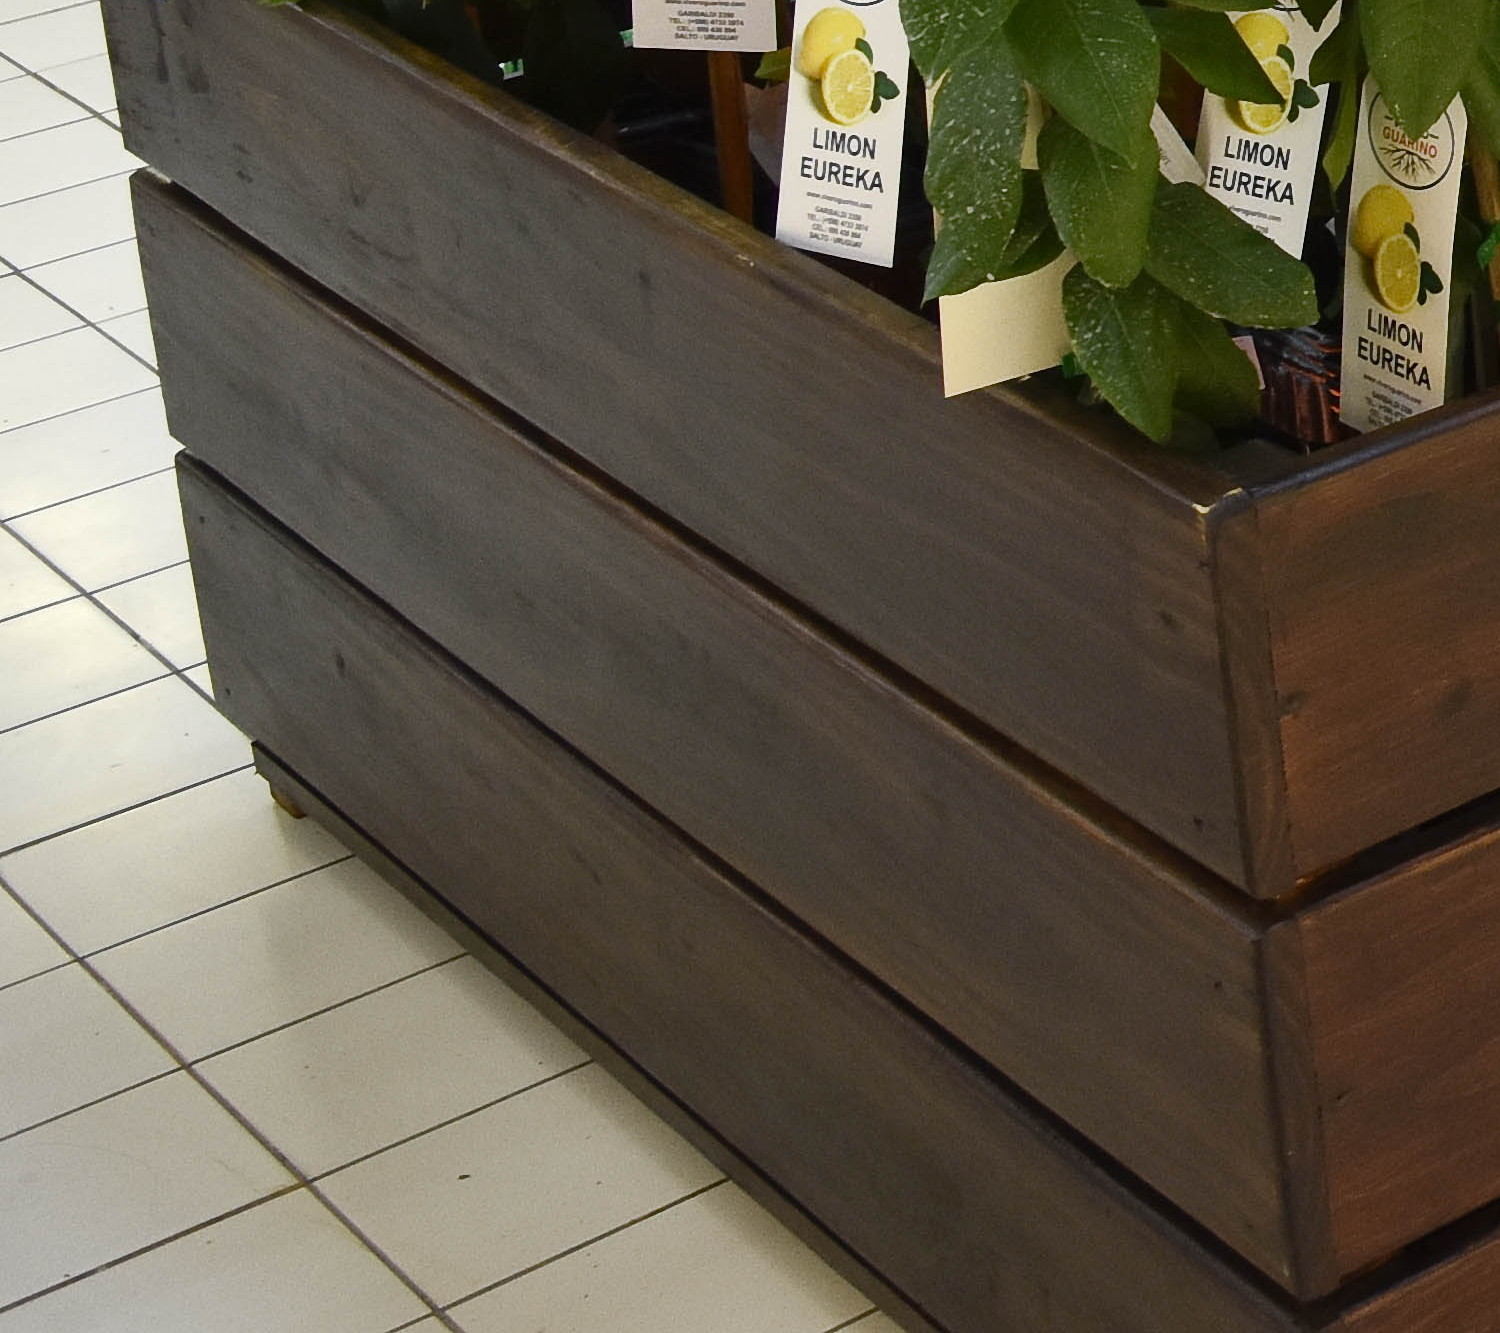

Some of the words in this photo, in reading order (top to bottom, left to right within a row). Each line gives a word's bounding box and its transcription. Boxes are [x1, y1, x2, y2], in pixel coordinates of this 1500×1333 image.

[812, 127, 877, 160] LIMON
[1224, 135, 1291, 171] LIMON
[800, 156, 884, 193] EUREKA
[1208, 165, 1295, 206] EUREKA
[1366, 307, 1424, 355] LIMON
[1356, 335, 1432, 392] EUREKA
